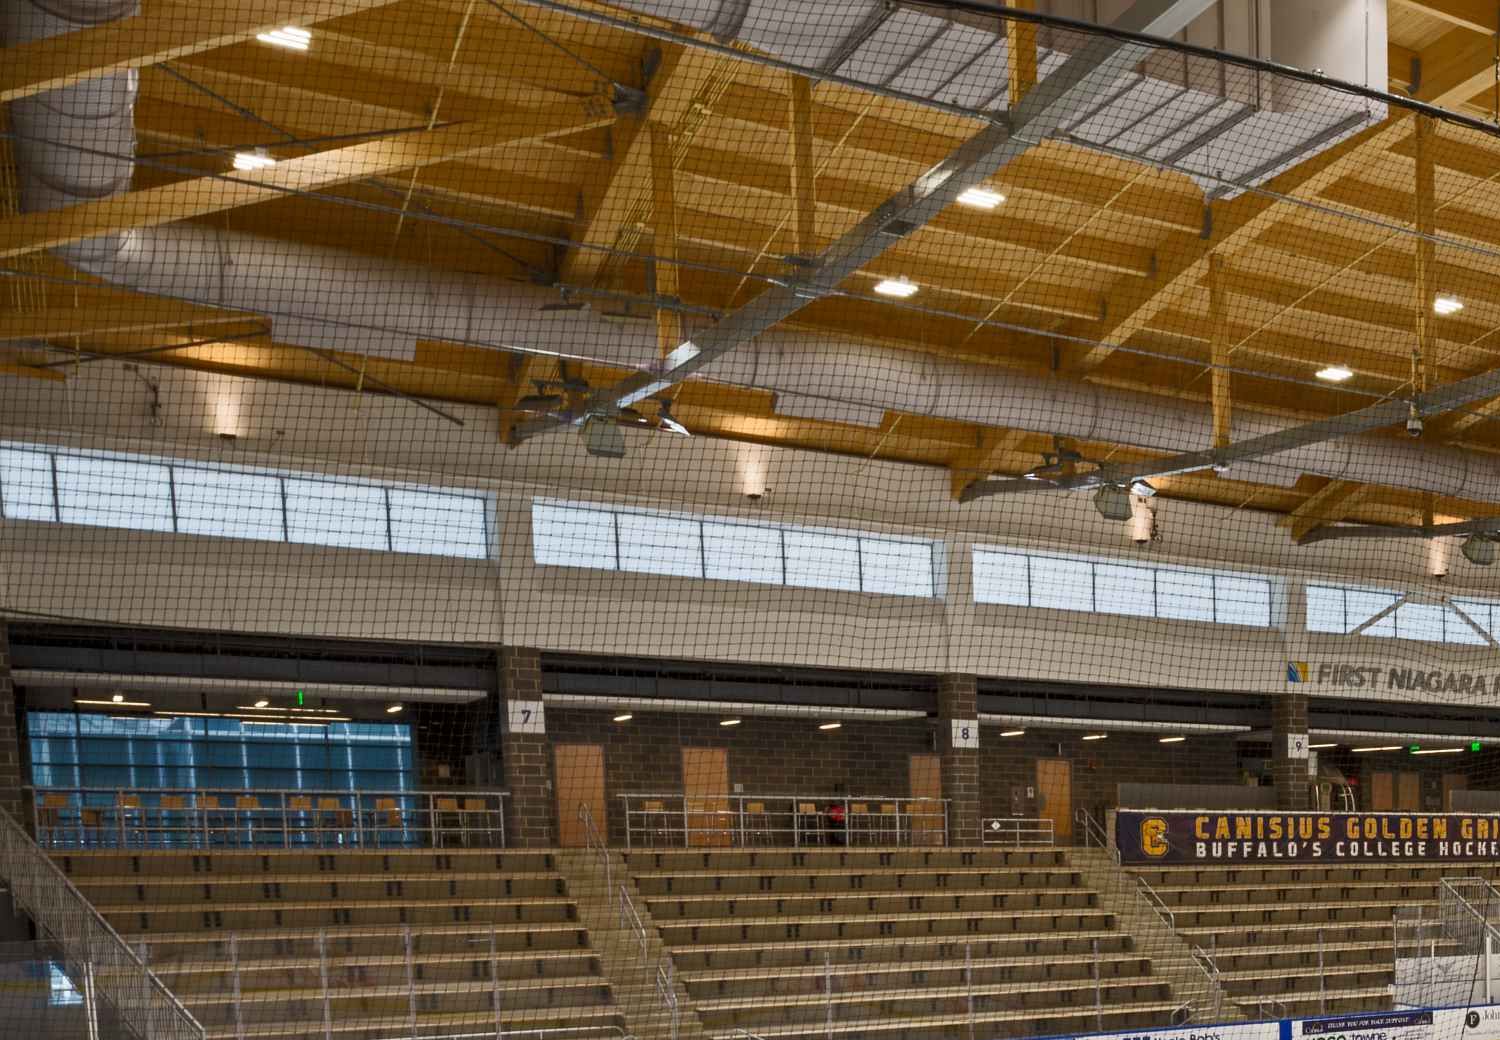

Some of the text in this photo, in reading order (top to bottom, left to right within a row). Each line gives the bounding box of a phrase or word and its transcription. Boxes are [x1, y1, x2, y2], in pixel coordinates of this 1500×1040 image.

[1318, 663, 1382, 689] FIRST
[1388, 667, 1485, 693] NIAGARA
[521, 710, 531, 724] 7
[962, 728, 969, 740] 8
[1295, 741, 1302, 752] 9
[1195, 816, 1331, 840] CANISIUS
[1347, 818, 1447, 840] GOLDEN
[1195, 841, 1322, 858] BUFFALO'S
[1336, 841, 1426, 857] COLLEGE
